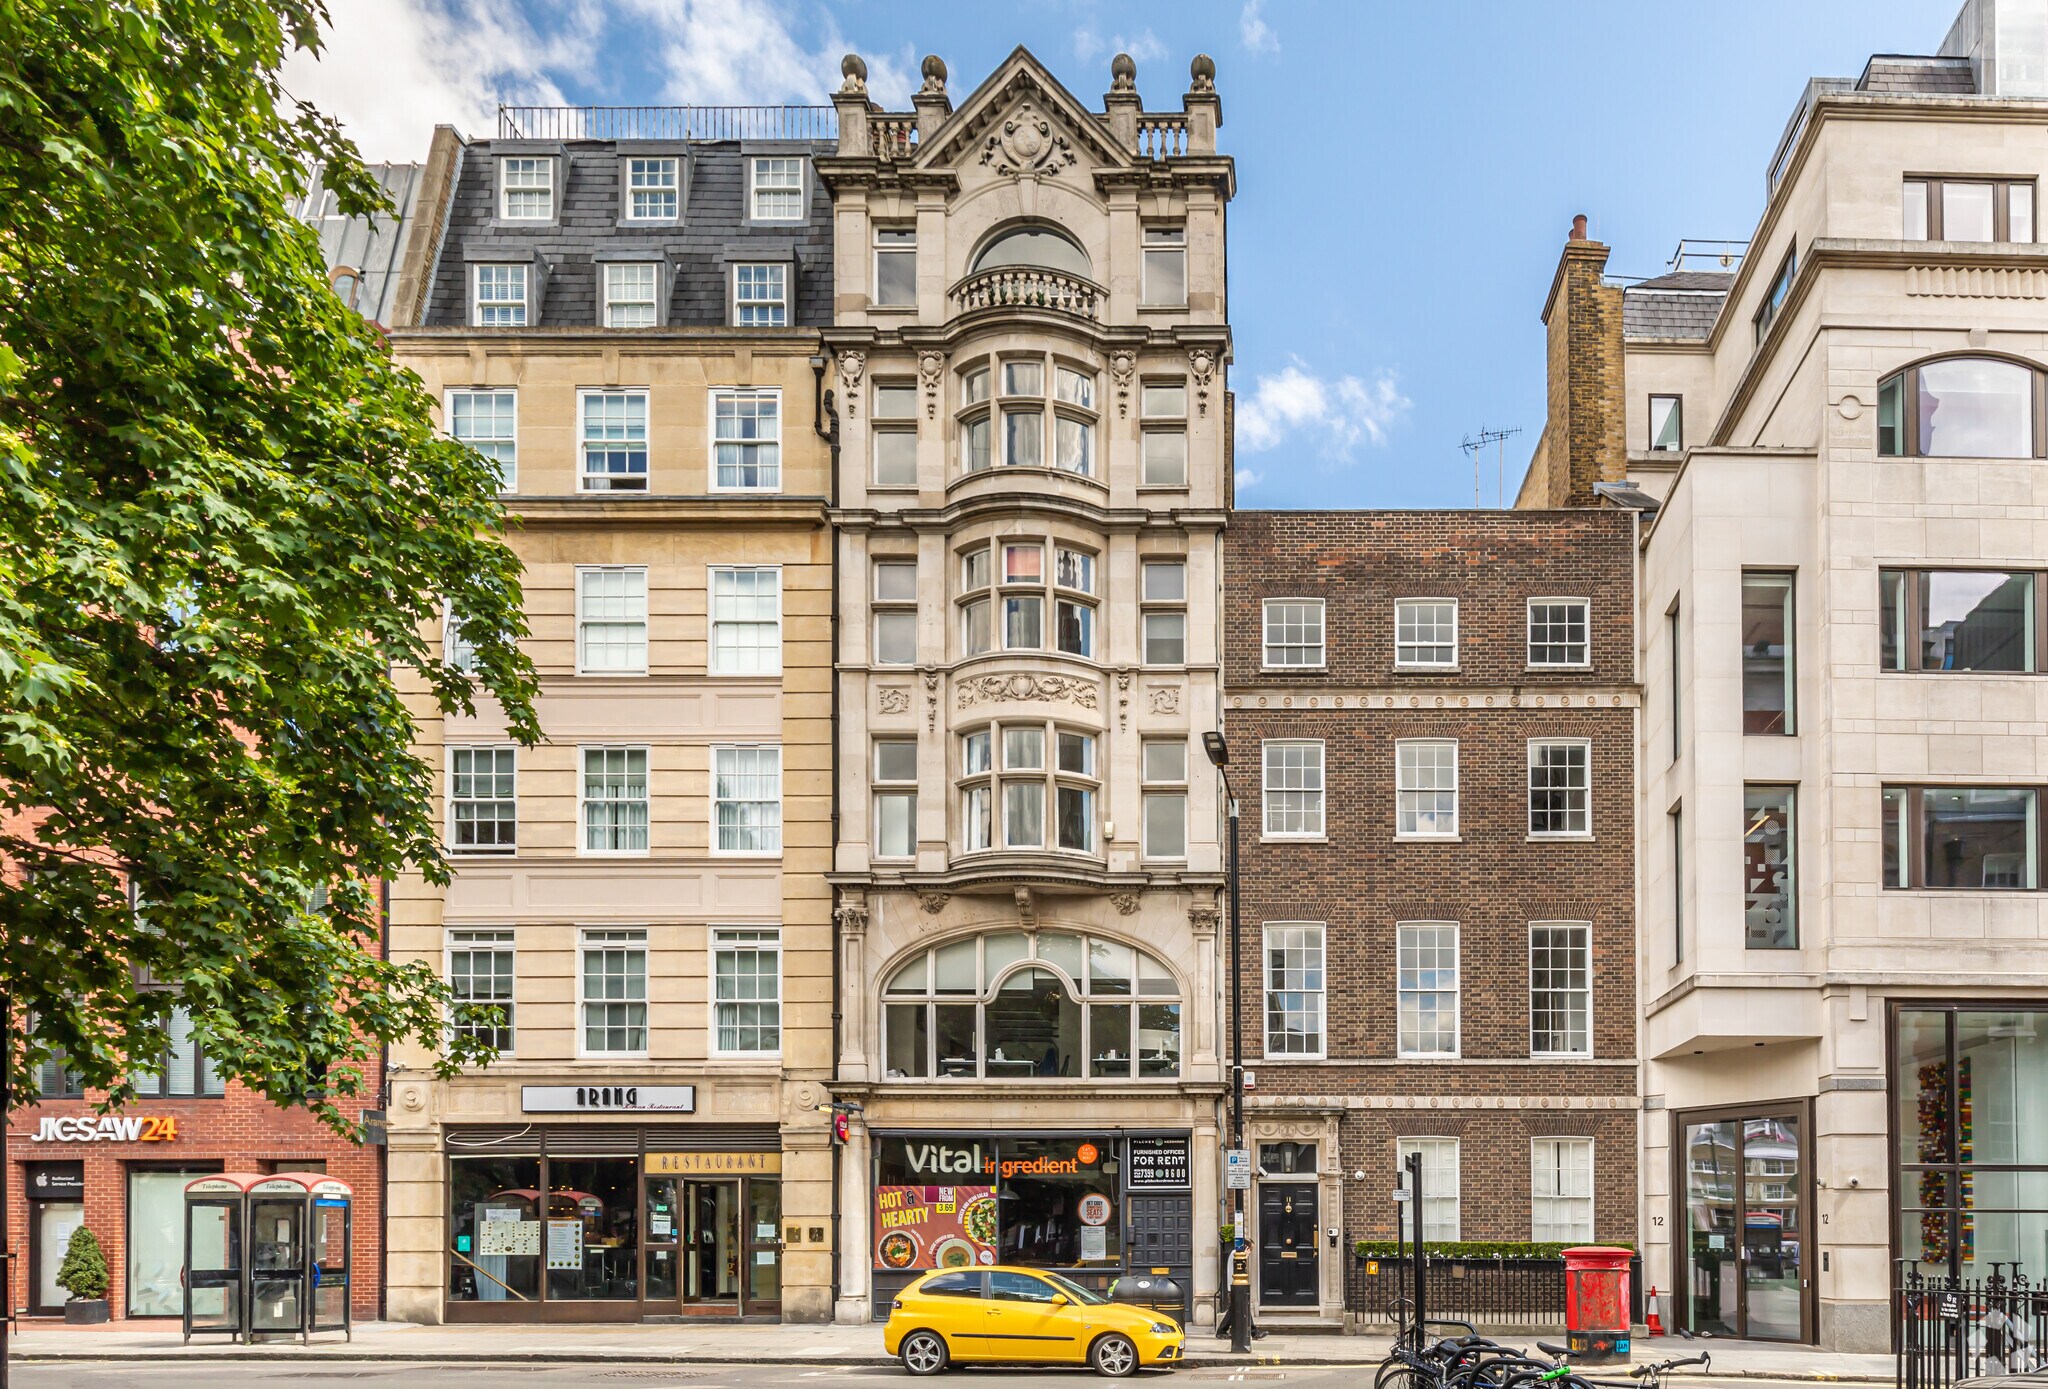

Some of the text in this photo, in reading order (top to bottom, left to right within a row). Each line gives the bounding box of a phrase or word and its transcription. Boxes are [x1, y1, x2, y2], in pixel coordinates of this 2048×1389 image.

[576, 1087, 637, 1107] ARANG
[31, 1116, 179, 1142] JIGSAW24
[662, 1155, 765, 1169] RESTAURANT
[905, 1143, 1079, 1178] Vital ingredient
[1133, 1156, 1185, 1165] FOR RENT
[1165, 1168, 1185, 1178] 8600
[939, 1187, 954, 1195] NEW
[879, 1190, 915, 1209] HOT &
[939, 1204, 954, 1212] 3.69
[881, 1207, 929, 1228] HEARTY
[1652, 1216, 1664, 1226] 12
[1822, 1214, 1829, 1224] 12
